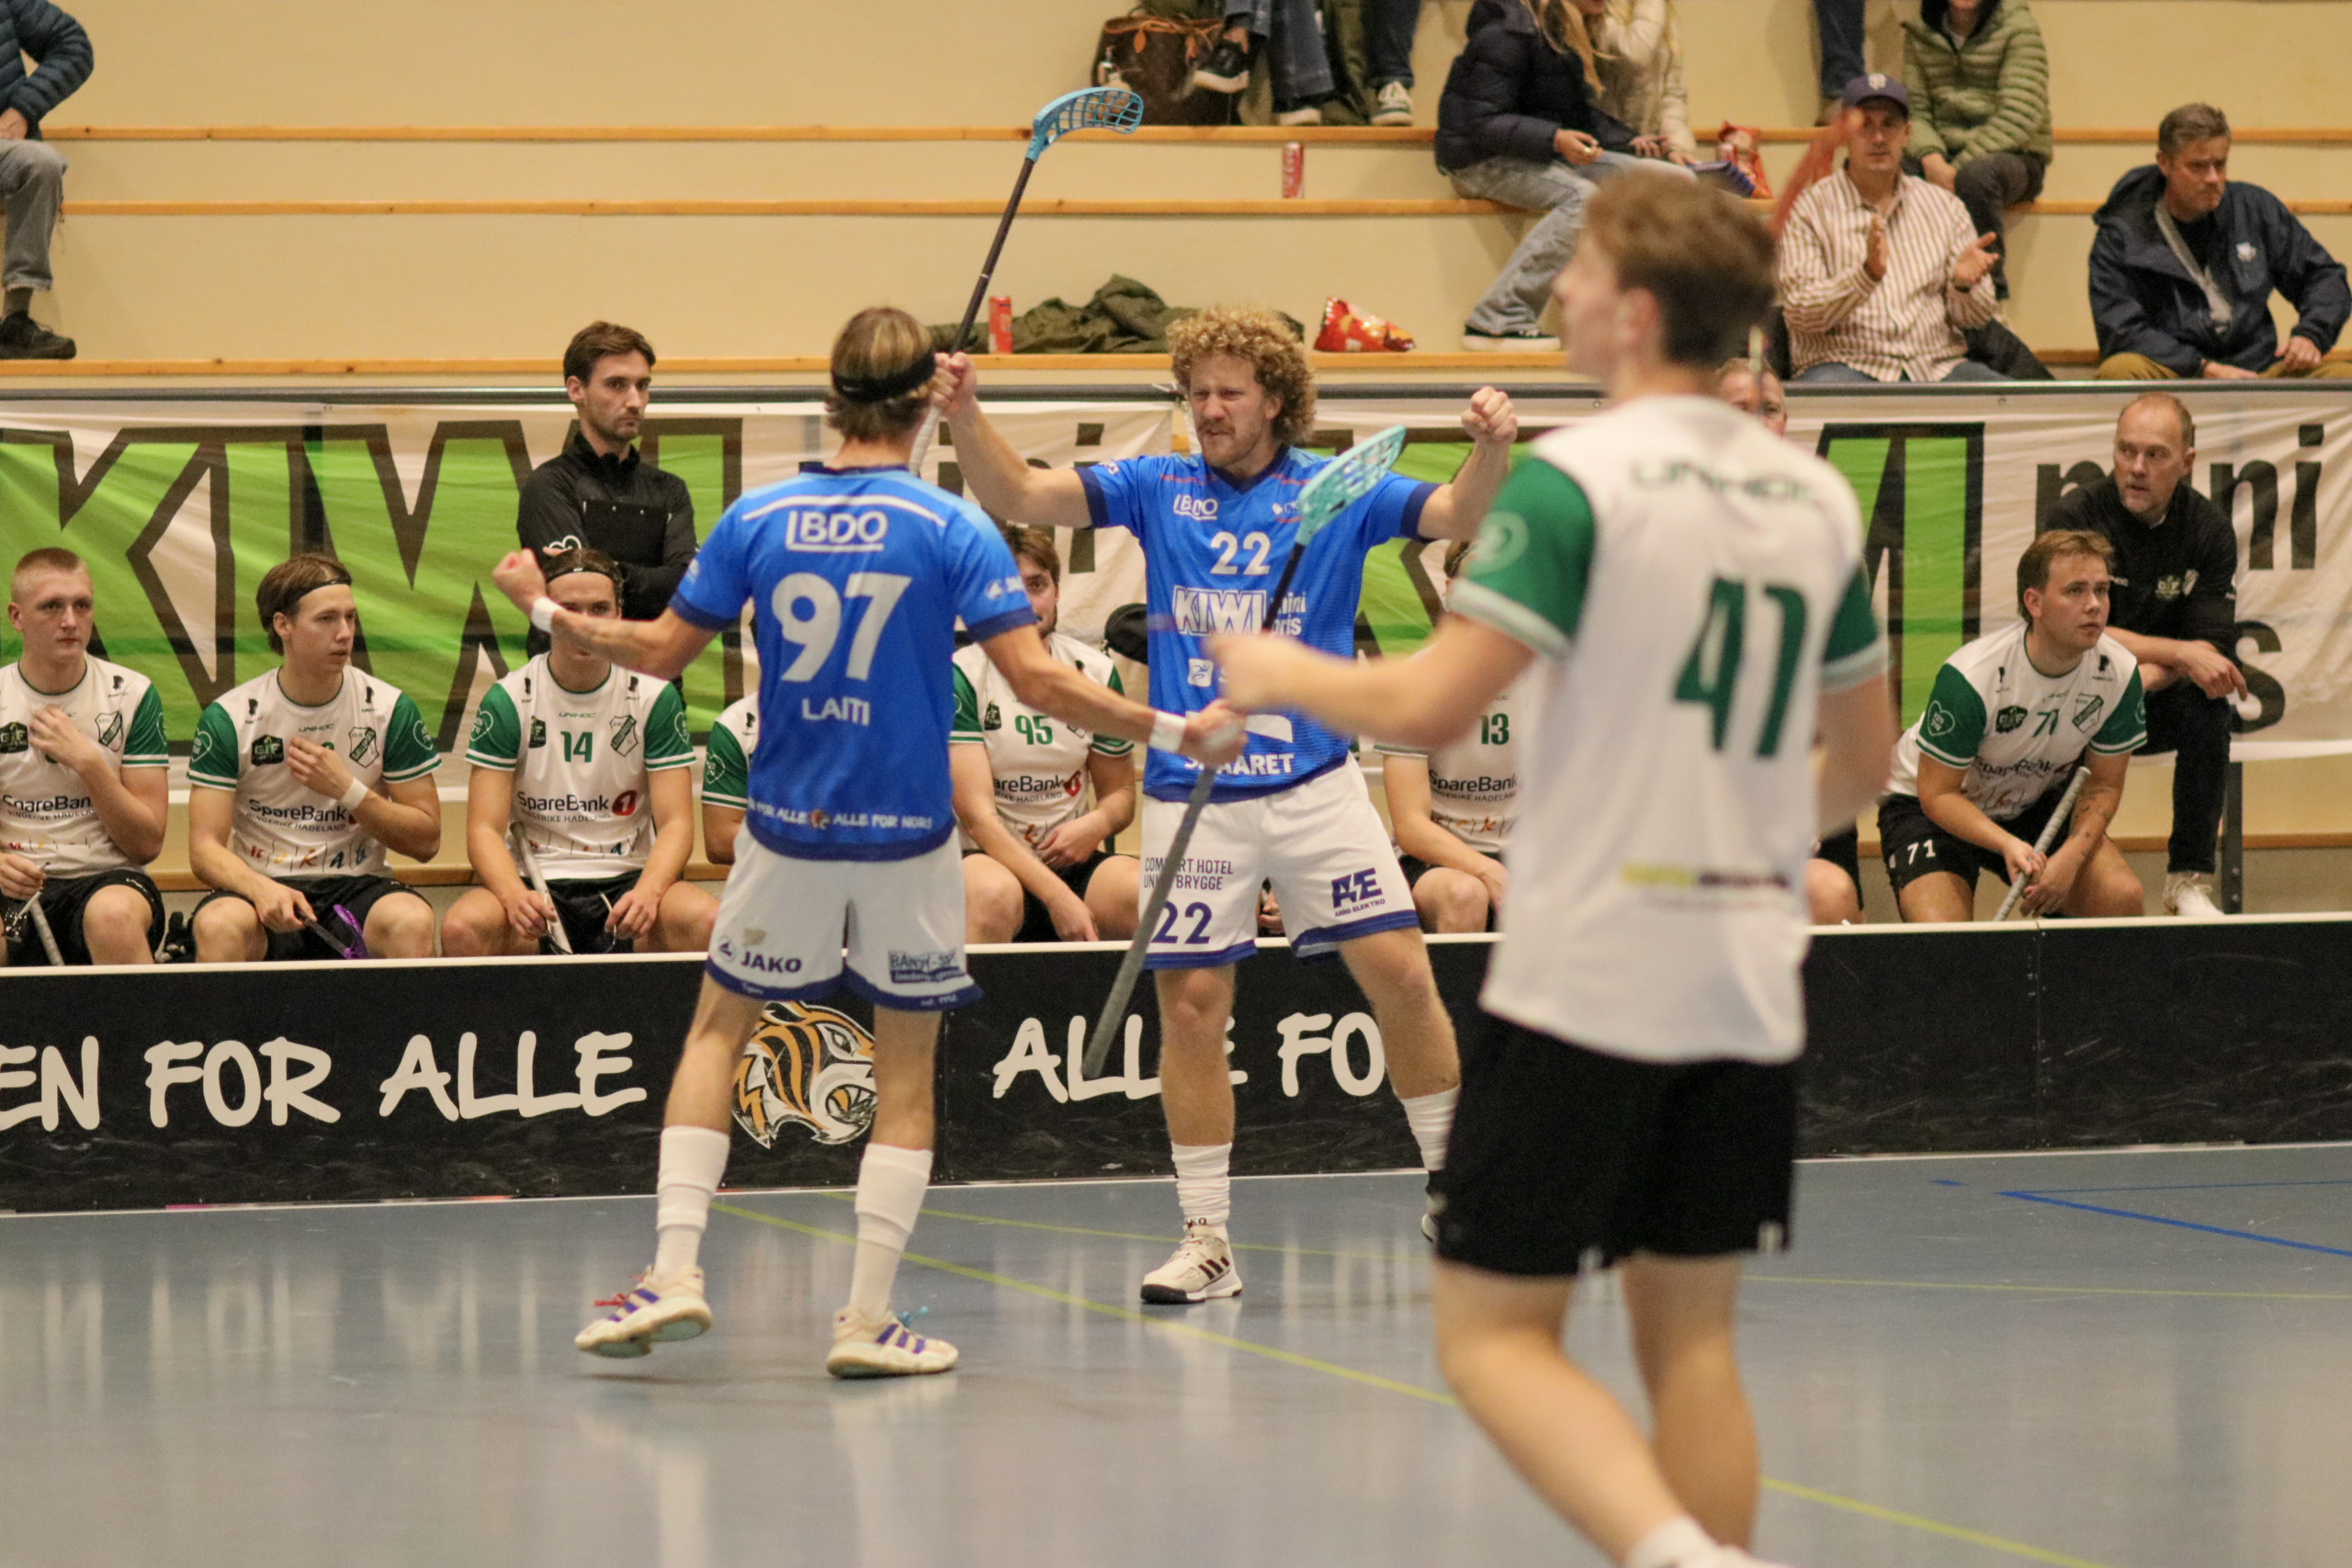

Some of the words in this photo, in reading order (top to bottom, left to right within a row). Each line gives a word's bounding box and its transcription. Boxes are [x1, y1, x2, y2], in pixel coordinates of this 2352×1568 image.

[1181, 494, 1218, 515] BDO
[798, 511, 888, 544] BDO
[1210, 531, 1271, 575] 22
[1172, 585, 1267, 636] KIWI
[772, 571, 912, 682] 97
[1671, 576, 1807, 760] 41
[1014, 715, 1053, 745] 95
[1480, 713, 1510, 745] 13
[2033, 708, 2059, 738] 71
[560, 730, 593, 763] 14
[1185, 754, 1295, 775] SAARET
[993, 774, 1064, 793] areBank
[249, 798, 346, 822] SpareBank
[517, 791, 609, 812] SpareBank
[831, 812, 869, 828] ALLE
[871, 813, 899, 829] FOR
[1145, 857, 1193, 874] COMRT
[1196, 859, 1234, 874] HOTEL
[1906, 840, 1937, 865] 71
[1176, 874, 1224, 890] BRYGGE
[1352, 898, 1385, 913] ELEKTRO
[1150, 900, 1213, 944] 22
[741, 951, 802, 973] JAKO
[1277, 1012, 1385, 1097] FO
[144, 1037, 341, 1128] FOR
[379, 1030, 648, 1122] ALLE
